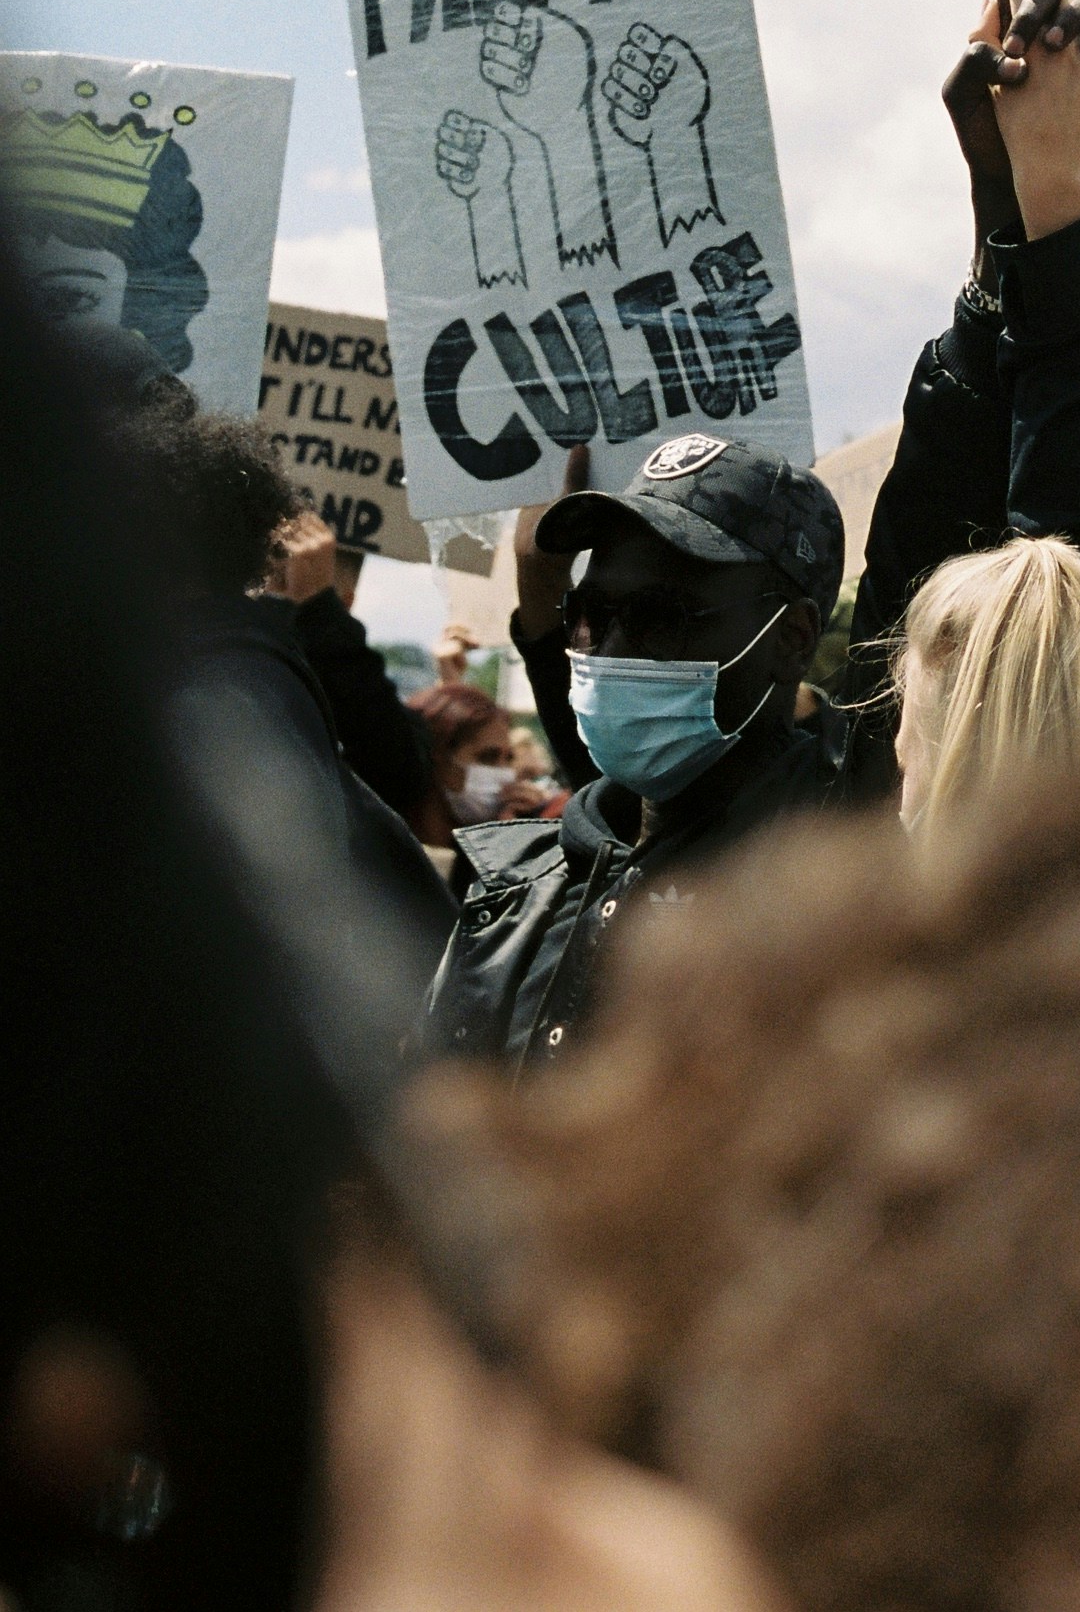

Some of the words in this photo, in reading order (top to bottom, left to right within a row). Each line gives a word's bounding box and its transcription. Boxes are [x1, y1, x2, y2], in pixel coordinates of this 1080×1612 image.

[264, 323, 394, 378] NDERS
[422, 230, 802, 482] CULTURE
[287, 379, 353, 424] I'LL
